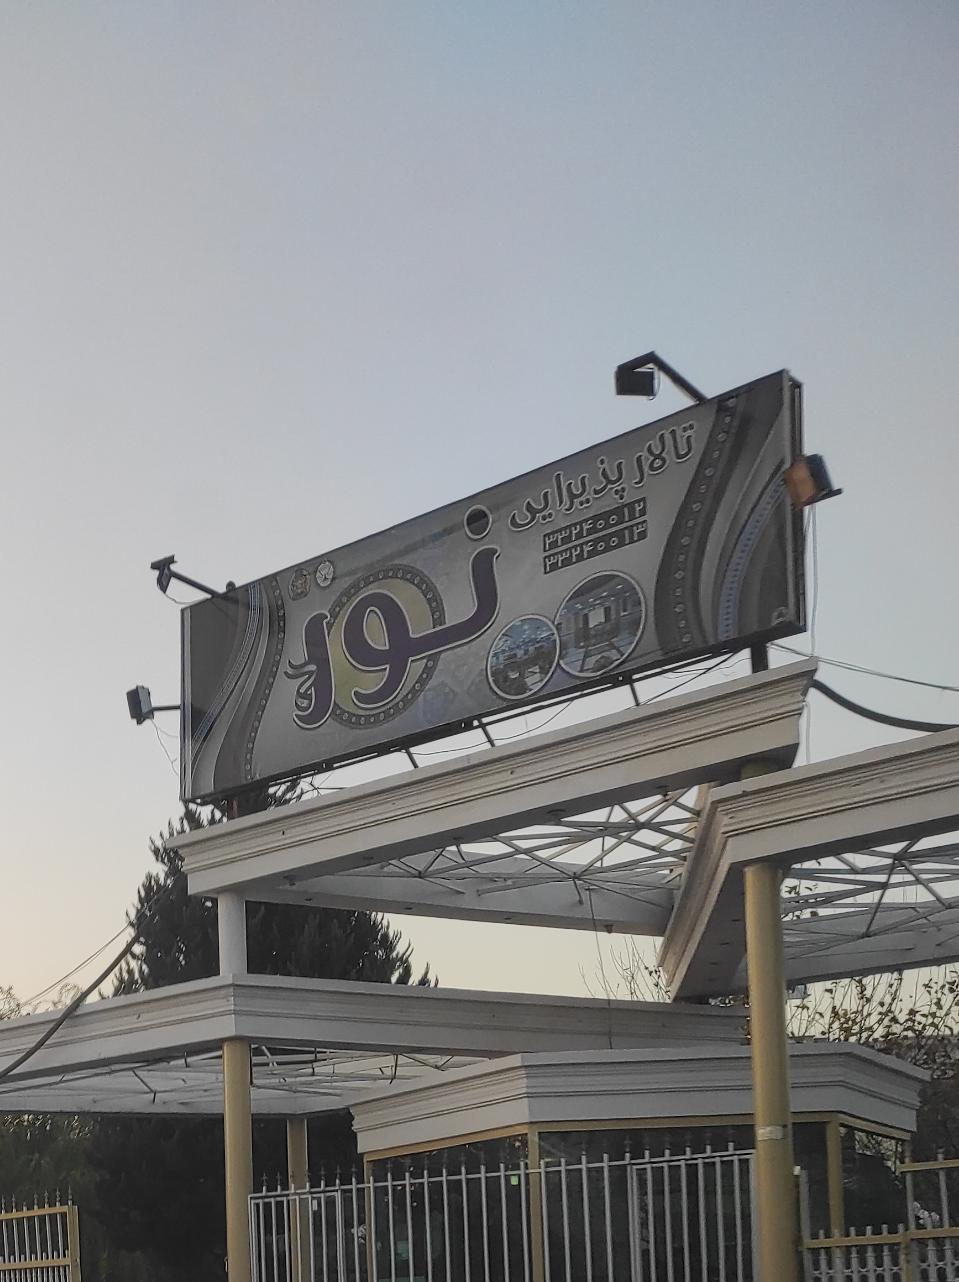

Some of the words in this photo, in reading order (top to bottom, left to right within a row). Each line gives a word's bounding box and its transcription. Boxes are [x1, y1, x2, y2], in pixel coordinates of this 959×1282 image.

[633, 421, 696, 487] تالار
[508, 456, 625, 532] پذیرایی
[544, 502, 645, 551] ۳۳۲۴۰۰۱۲
[545, 524, 646, 573] ۳۳۲۴۰۰۱۳
[283, 505, 500, 730] نور
